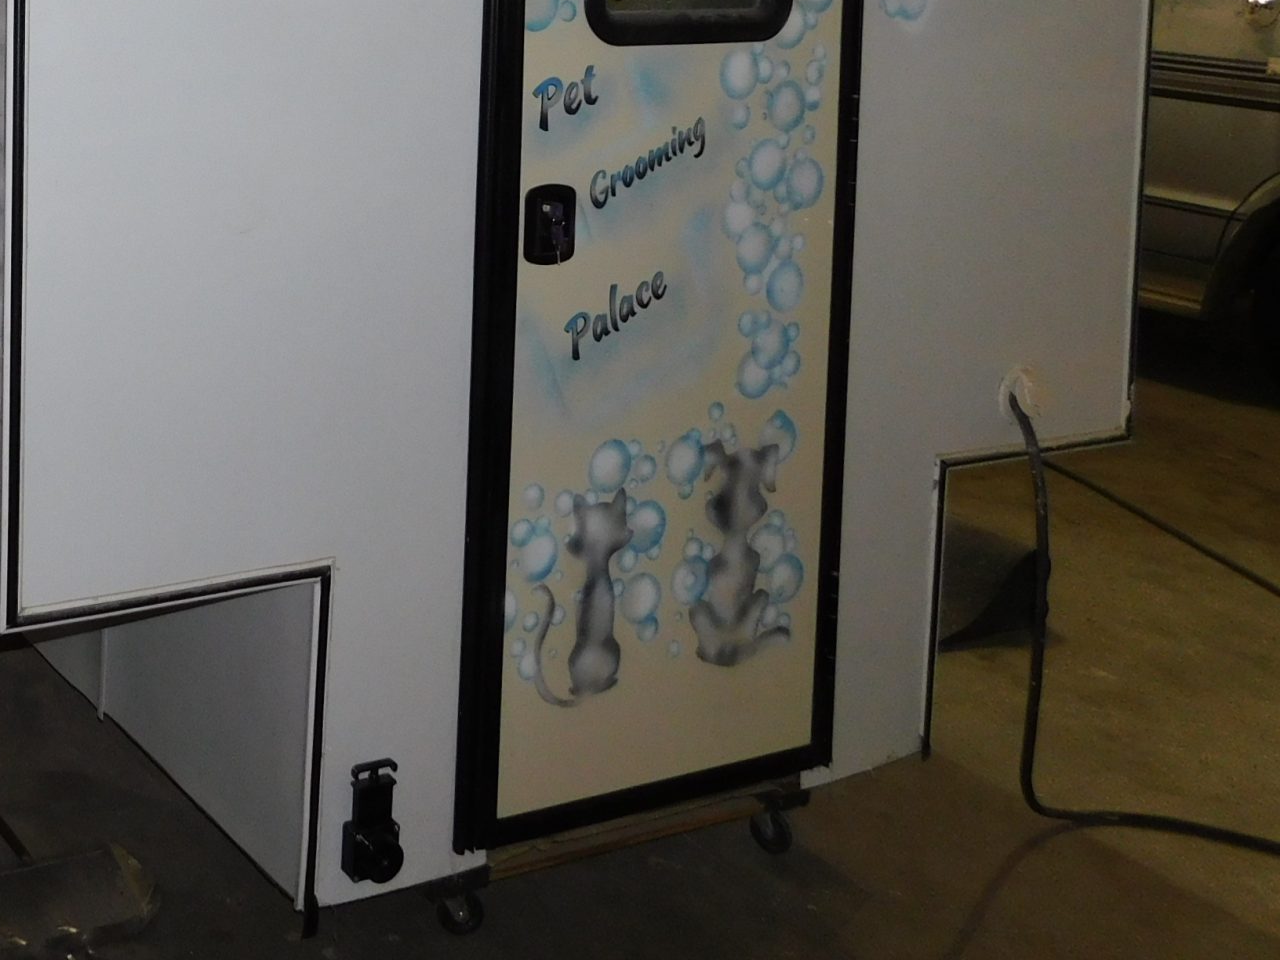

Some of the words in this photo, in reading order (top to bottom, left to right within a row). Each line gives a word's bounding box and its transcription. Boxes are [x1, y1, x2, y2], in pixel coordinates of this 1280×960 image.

[532, 65, 598, 132] Pet
[589, 116, 706, 209] Grooming
[564, 270, 667, 361] Palace
